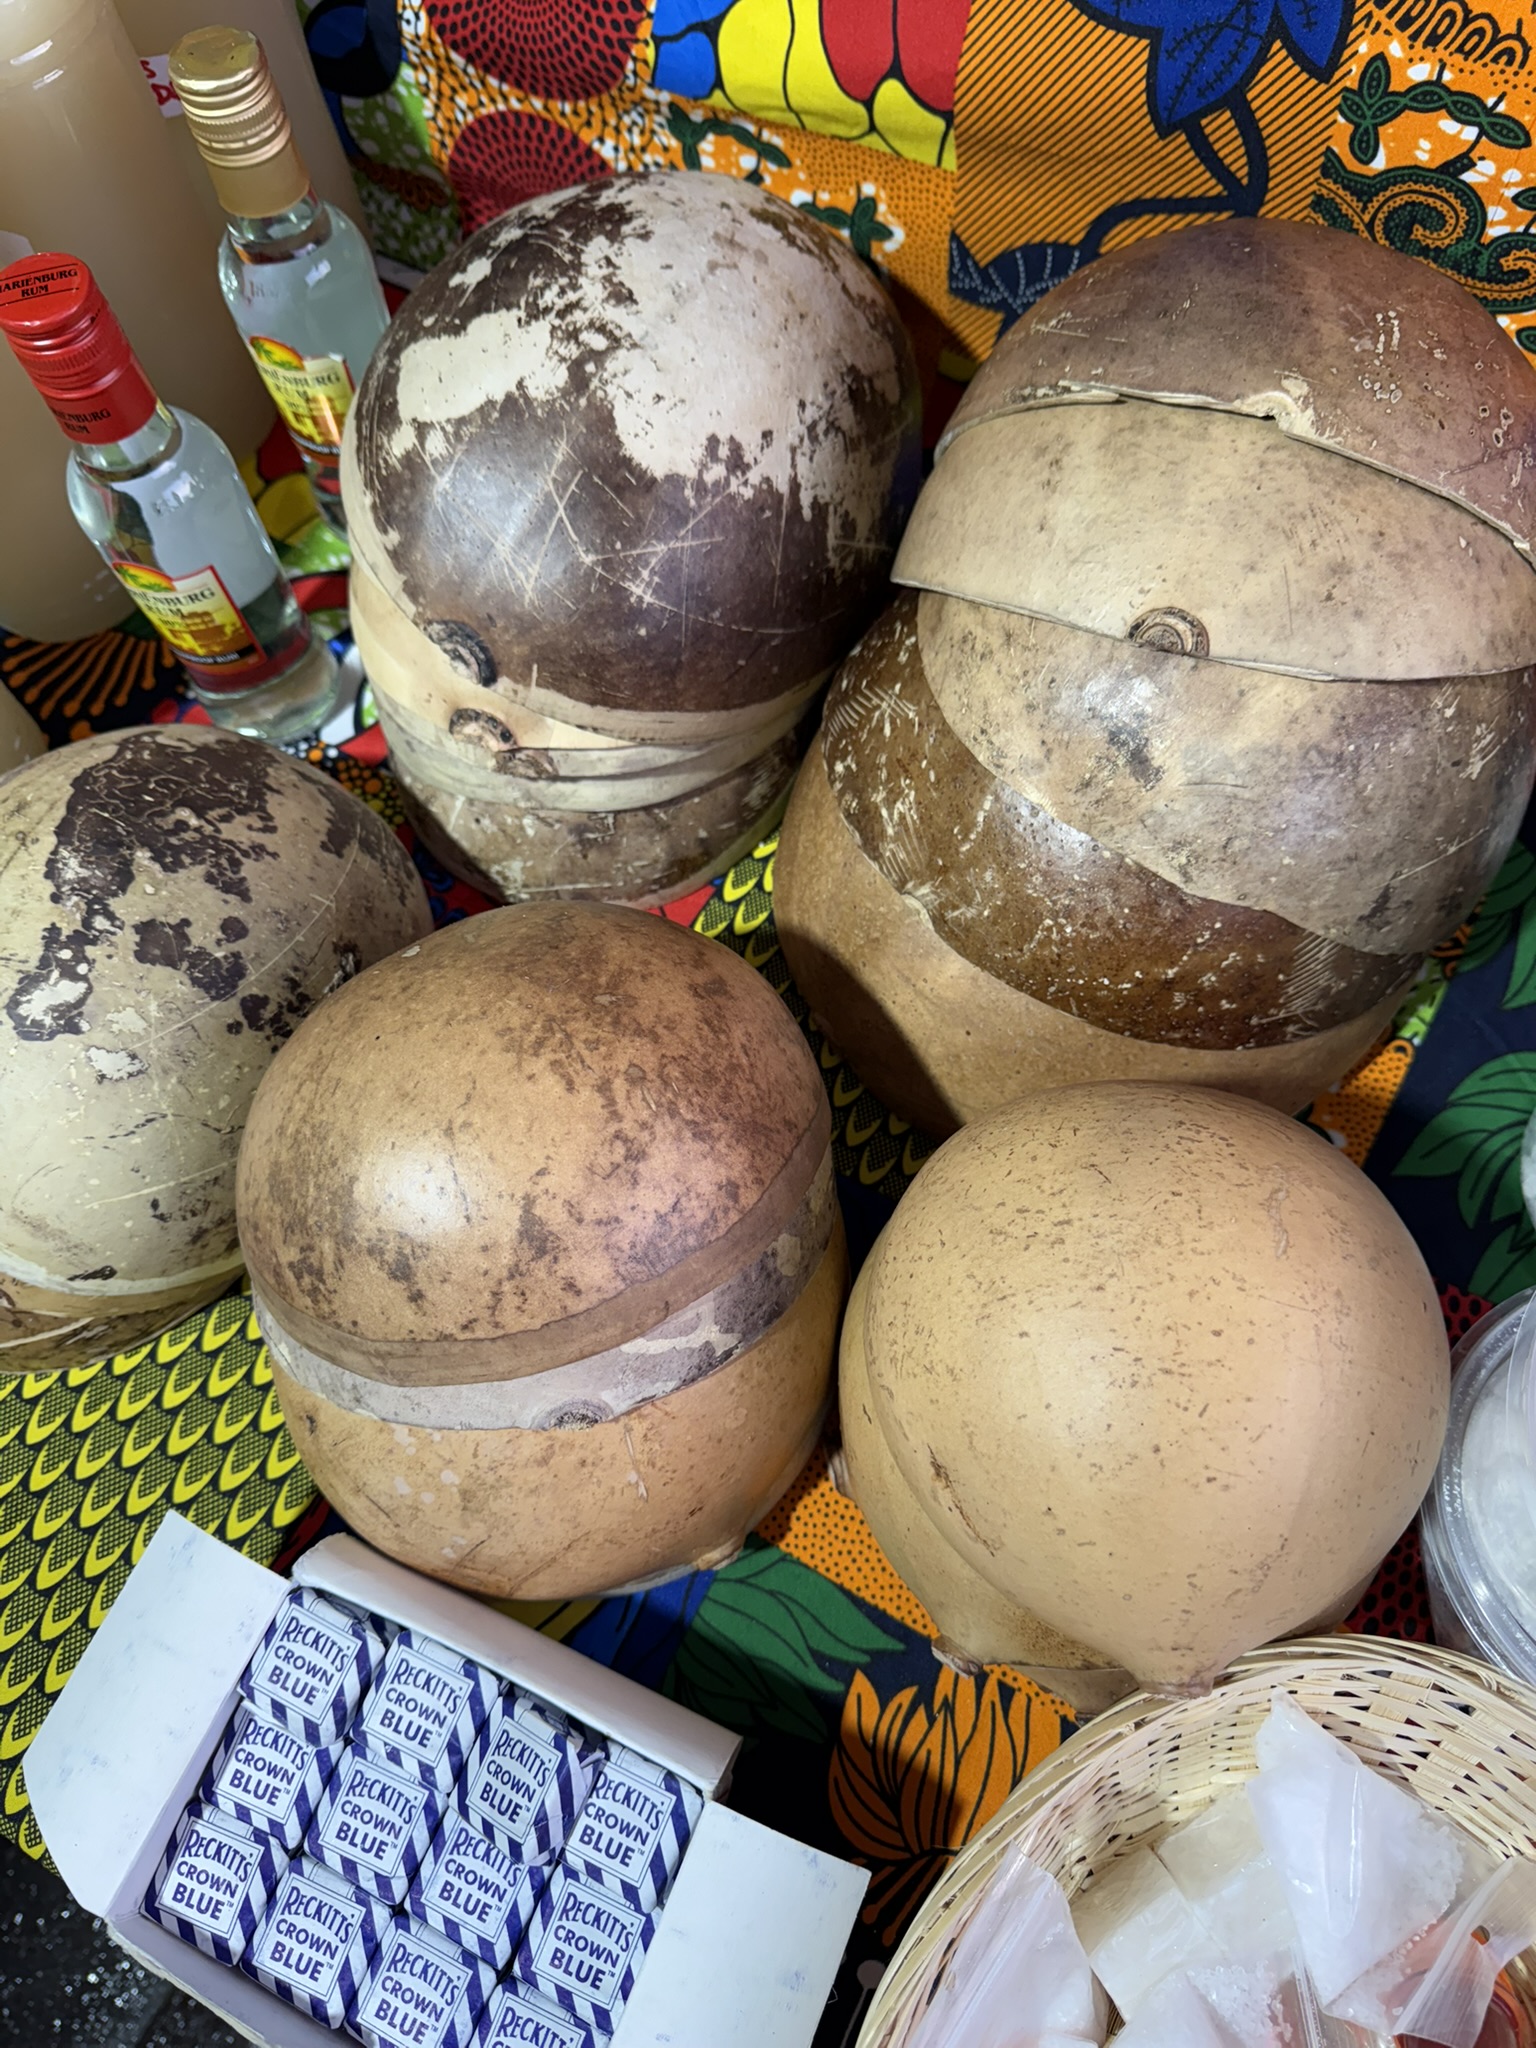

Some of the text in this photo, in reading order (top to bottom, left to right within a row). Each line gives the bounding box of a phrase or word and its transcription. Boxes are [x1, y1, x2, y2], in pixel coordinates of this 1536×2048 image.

[21, 284, 49, 298] RUM
[275, 1645, 334, 1687] CROWN
[279, 1616, 350, 1672] RECKITT'S
[386, 1688, 447, 1729] CROWN
[391, 1658, 464, 1714] RECKITT'S
[235, 1749, 295, 1786] CROWN
[487, 1760, 536, 1802] CROWN
[491, 1730, 552, 1787] RECKITT'S
[347, 1769, 418, 1824] RECKITT'S
[592, 1771, 665, 1831] RECKITT'S
[341, 1800, 403, 1840] CROWN
[584, 1802, 650, 1846] CROWN
[181, 1829, 253, 1882] RECKITT'S
[177, 1861, 239, 1898] CROWN
[445, 1858, 508, 1903] CROWN
[281, 1886, 353, 1944] RECKITT'S
[558, 1892, 634, 1953] RECKITT'S
[276, 1918, 339, 1960] CROWN
[554, 1925, 620, 1968] CROWN
[386, 1943, 460, 2006] RECKITT'S
[381, 1976, 444, 2023] CROWN
